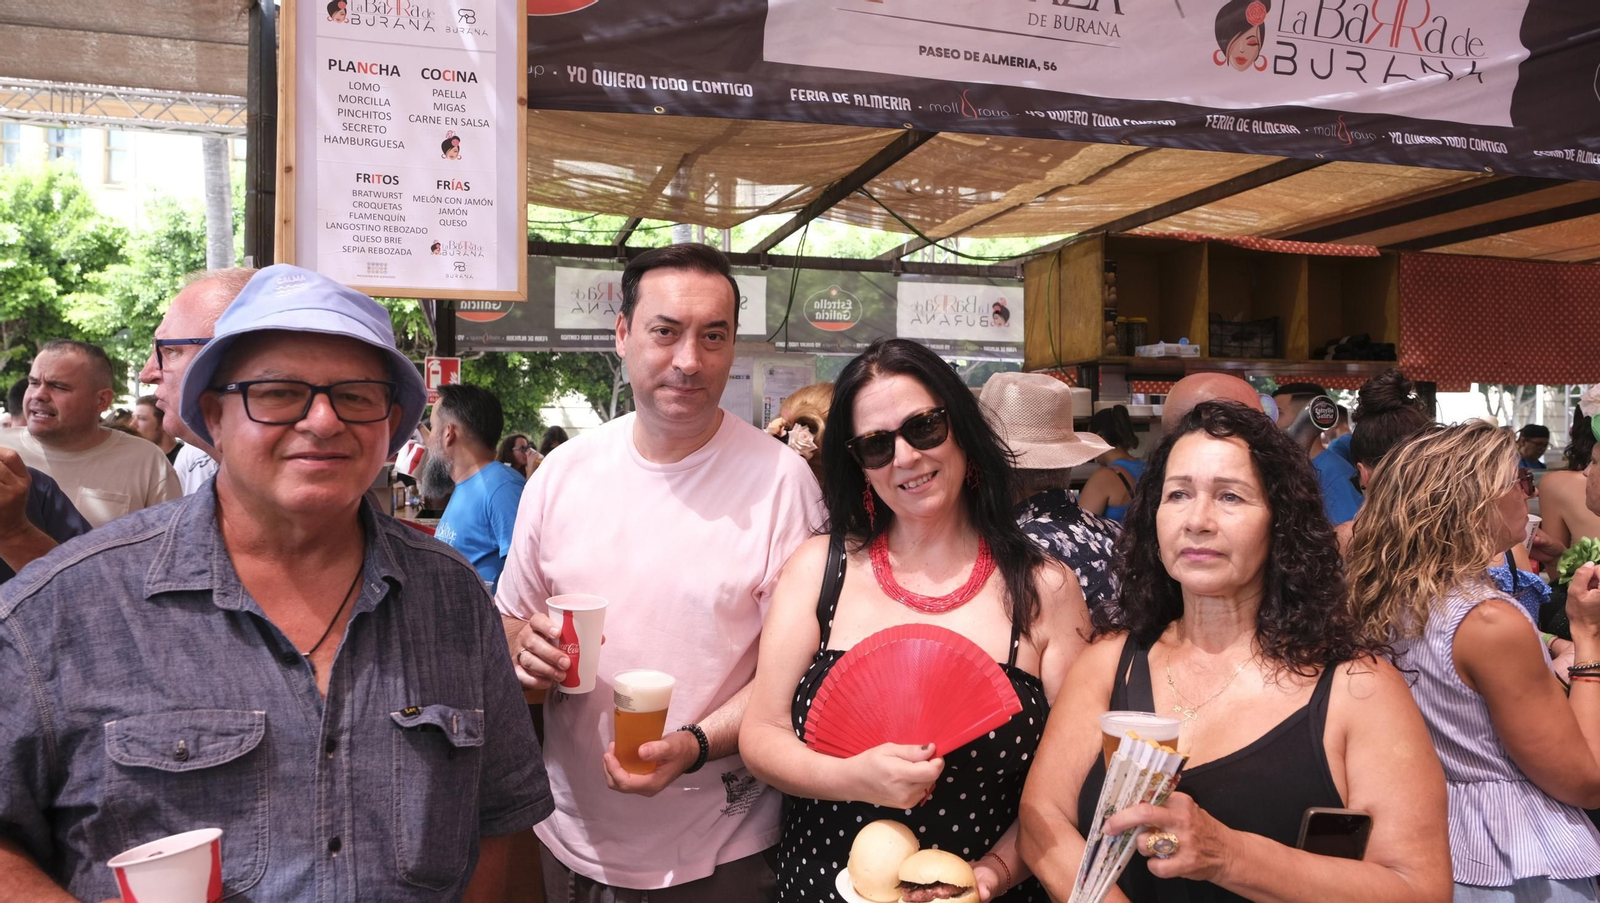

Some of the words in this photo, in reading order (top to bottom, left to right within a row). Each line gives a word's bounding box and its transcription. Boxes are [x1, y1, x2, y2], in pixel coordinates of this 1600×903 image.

[351, 14, 436, 32] BURANA
[1028, 12, 1048, 28] DE
[1053, 15, 1121, 38] BURANA
[445, 26, 488, 36] BURANA
[1451, 28, 1486, 57] de
[919, 45, 961, 60] PASEO
[964, 50, 980, 62] DE
[982, 52, 1041, 71] ALMERIA,
[1043, 61, 1057, 72] 56
[1273, 41, 1484, 84] BURANA
[328, 59, 401, 77] PLANCHA
[421, 68, 478, 83] COCINA
[567, 65, 587, 83] YO
[592, 69, 646, 89] QUIERO
[650, 76, 689, 92] TODO
[692, 80, 754, 98] CONTIGO
[349, 82, 381, 92] LOMO
[432, 89, 467, 99] PAELLA
[338, 95, 391, 107] MORCILLA
[433, 102, 466, 113] MIGAS
[790, 88, 829, 102] FERIA
[832, 92, 851, 104] DE
[853, 94, 912, 111] ALMERIA
[1047, 110, 1089, 126] QUIERO
[337, 108, 392, 121] PINCHITOS
[408, 114, 442, 125] CARNE
[445, 116, 458, 126] EN
[460, 117, 490, 128] SALSA
[342, 122, 387, 135] SECRETO
[1205, 115, 1234, 129] FERIA
[1236, 118, 1250, 133] DE
[1252, 120, 1301, 135] ALMERIA
[1389, 132, 1403, 144] YO
[1441, 136, 1467, 149] TODO
[1469, 137, 1508, 154] CONTIGO
[324, 135, 405, 150] HAMBURGUESA
[1564, 149, 1575, 161] DE
[356, 172, 400, 186] FRITOS
[436, 179, 471, 192] FRÍAS
[352, 189, 403, 200] BRATWURST
[412, 194, 443, 205] MELÓN
[444, 196, 462, 206] CON
[464, 196, 494, 207] JAMÓN
[352, 201, 403, 212] CROQUETAS
[438, 207, 468, 217] JAMÓN
[349, 211, 406, 223] FLAMENQUÍN
[439, 218, 468, 228] QUESO
[325, 222, 381, 233] LANGOSTINO
[383, 225, 428, 235] REBOZADO
[352, 234, 382, 245] QUESO
[384, 235, 403, 245] BRIE
[342, 245, 366, 255] SEPIA
[368, 246, 412, 256] REBOZADA
[277, 274, 306, 284] CALMA
